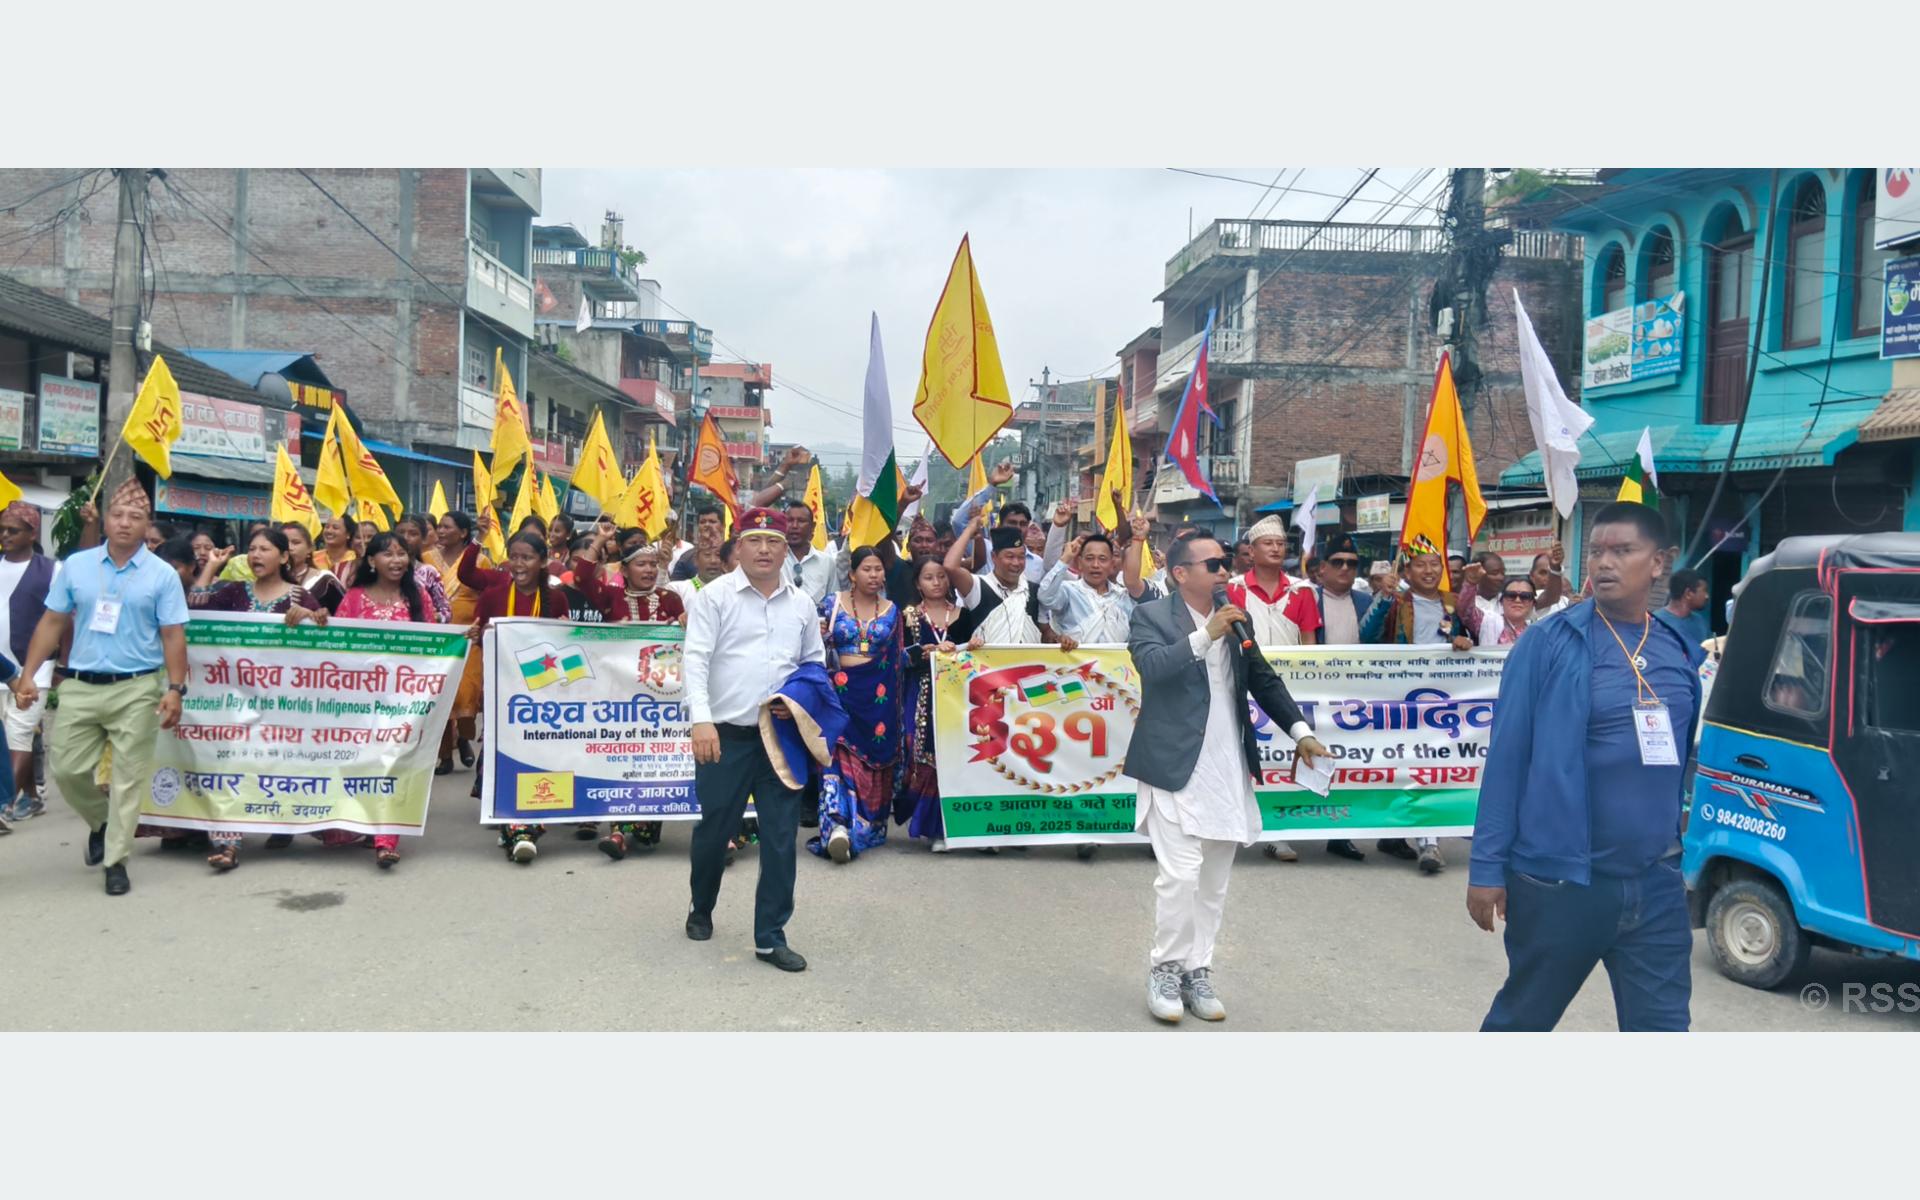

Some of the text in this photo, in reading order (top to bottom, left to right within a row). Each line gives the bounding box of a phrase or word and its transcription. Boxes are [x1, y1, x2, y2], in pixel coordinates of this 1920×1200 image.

[1357, 659, 1363, 667] र
[236, 658, 284, 689] विश्व
[290, 661, 388, 694] आदिवासी
[395, 665, 448, 696] दिवस
[1290, 671, 1340, 680] ILO169
[226, 693, 245, 712] Day
[248, 695, 258, 710] of
[277, 696, 313, 714] Worlds
[316, 698, 372, 718] Indigenous
[374, 700, 408, 719] Peoples
[507, 693, 691, 730] विश्व आदिवा
[1329, 687, 1498, 738] आदिव
[260, 724, 305, 744] साथ
[311, 727, 372, 745] सफल
[523, 727, 692, 742] International Day of the World
[1010, 711, 1108, 774] ३१
[585, 742, 645, 754] भव्यताका
[650, 741, 676, 754] साथ
[1329, 744, 1375, 764] Day
[1382, 743, 1405, 760] of
[1414, 742, 1450, 759] the
[257, 774, 331, 798] एकता
[343, 776, 398, 797] समाज
[1409, 766, 1479, 786] साथ
[1731, 774, 1792, 796] DURAMAX
[586, 786, 690, 802] दनुवार जागरण
[952, 799, 993, 813] २०८२
[1000, 799, 1047, 812] श्रावण
[1052, 798, 1074, 811] २४
[1080, 795, 1105, 810] गते
[244, 801, 333, 818] कटारी, उदयपुर
[608, 803, 636, 814] कटारी
[1272, 803, 1352, 820] उदयपुर
[986, 819, 1137, 835] Aug 09, 2025 Saturday
[1716, 808, 1786, 841] 9842808260
